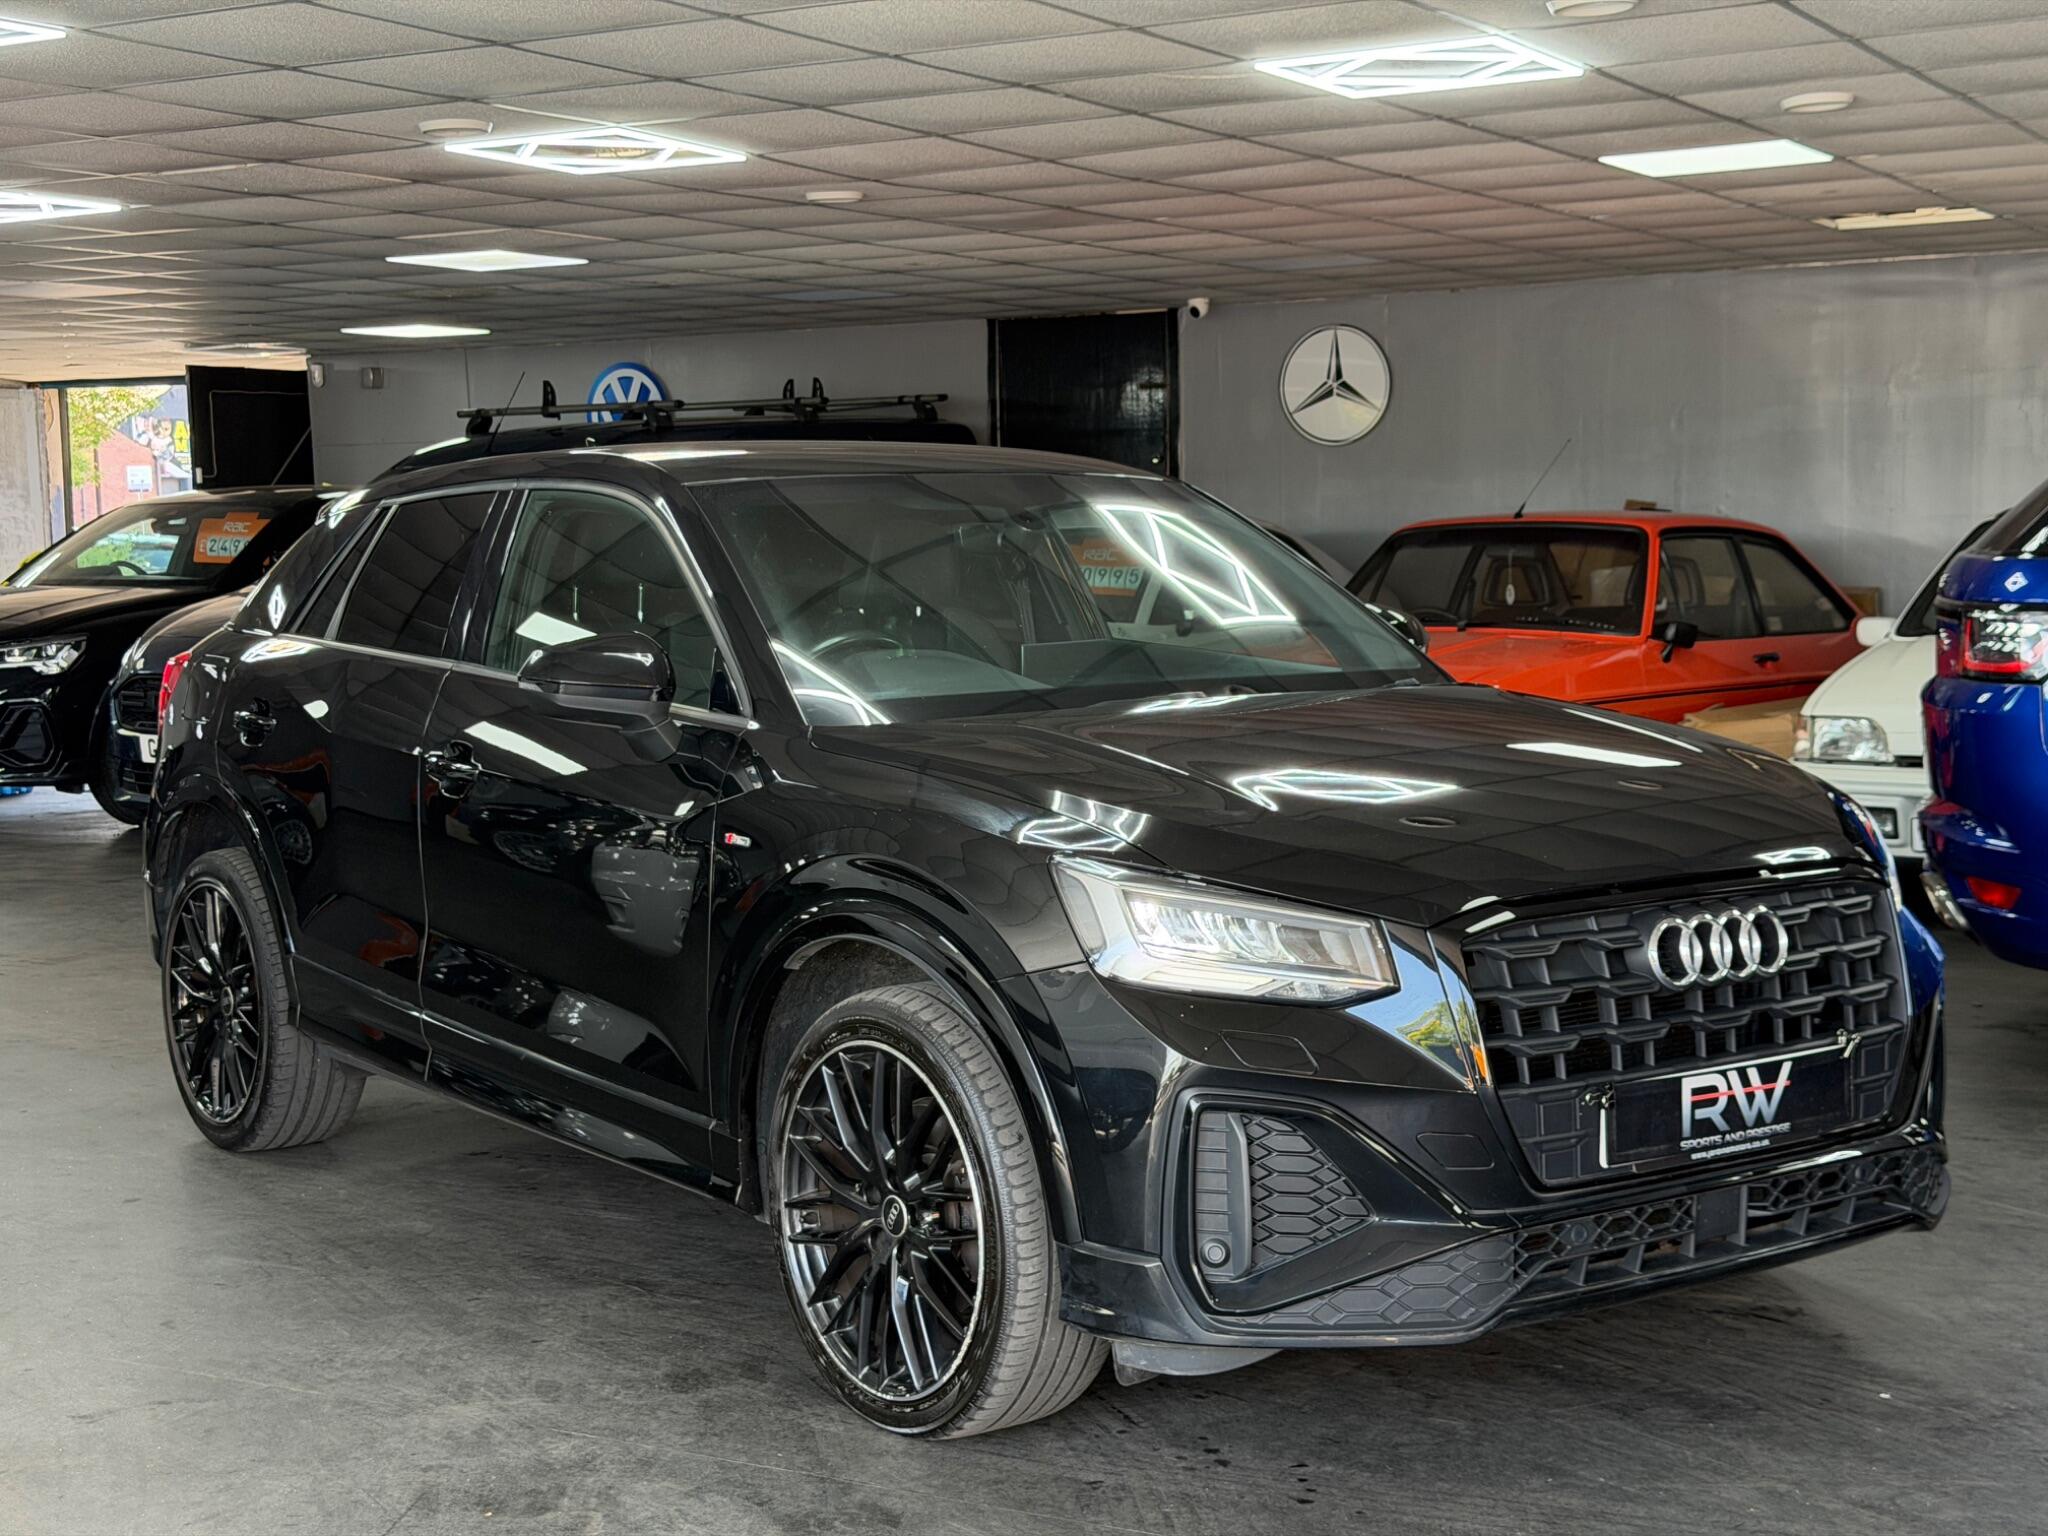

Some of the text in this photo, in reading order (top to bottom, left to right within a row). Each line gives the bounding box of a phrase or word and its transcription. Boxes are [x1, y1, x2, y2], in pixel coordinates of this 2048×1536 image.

[1681, 1060, 1793, 1138] RW
[1680, 1134, 1723, 1151] SPORTS
[1723, 1131, 1745, 1144] AND
[1746, 1122, 1792, 1139] PRESTIGE
